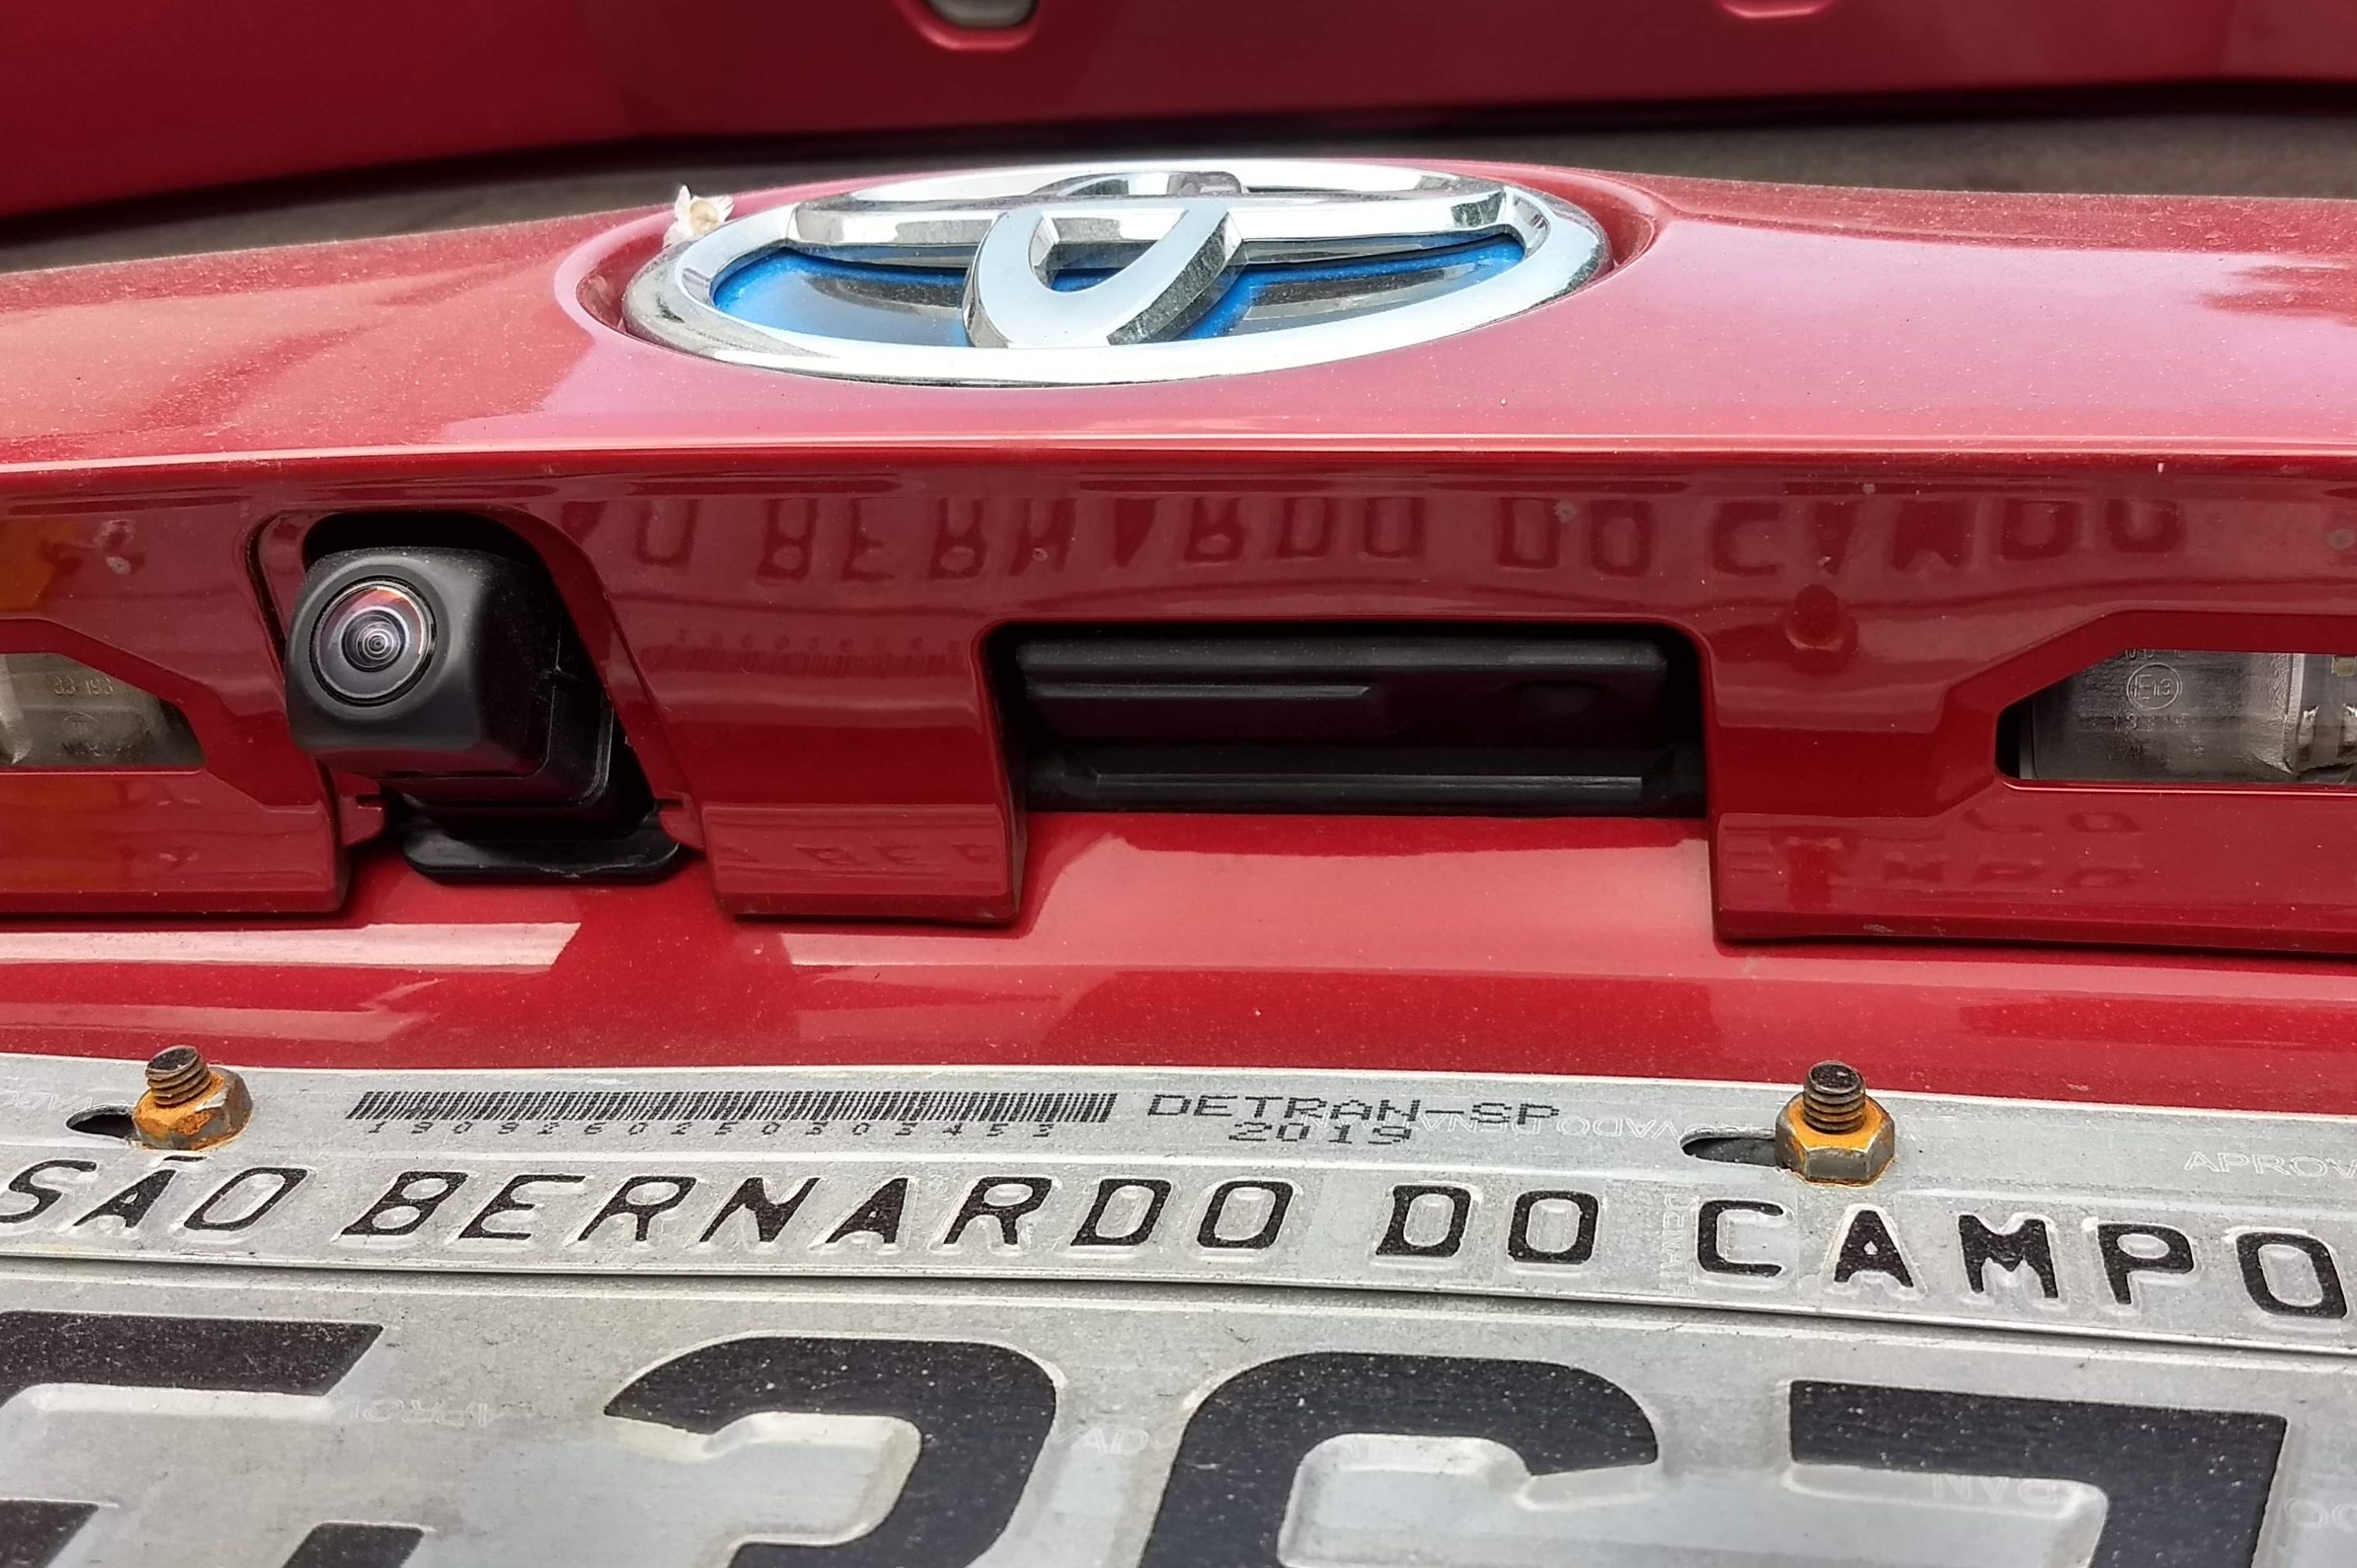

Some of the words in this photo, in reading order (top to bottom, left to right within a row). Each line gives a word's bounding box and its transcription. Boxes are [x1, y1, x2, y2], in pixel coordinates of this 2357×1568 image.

[1147, 1093, 1560, 1126] DETRAN-SP
[1227, 1122, 1413, 1146] 2019
[0, 1155, 311, 1233] SÃO
[340, 1170, 1295, 1250] BERNARDO
[1374, 1182, 1600, 1266] DO
[1695, 1198, 2349, 1320] CAMPO
